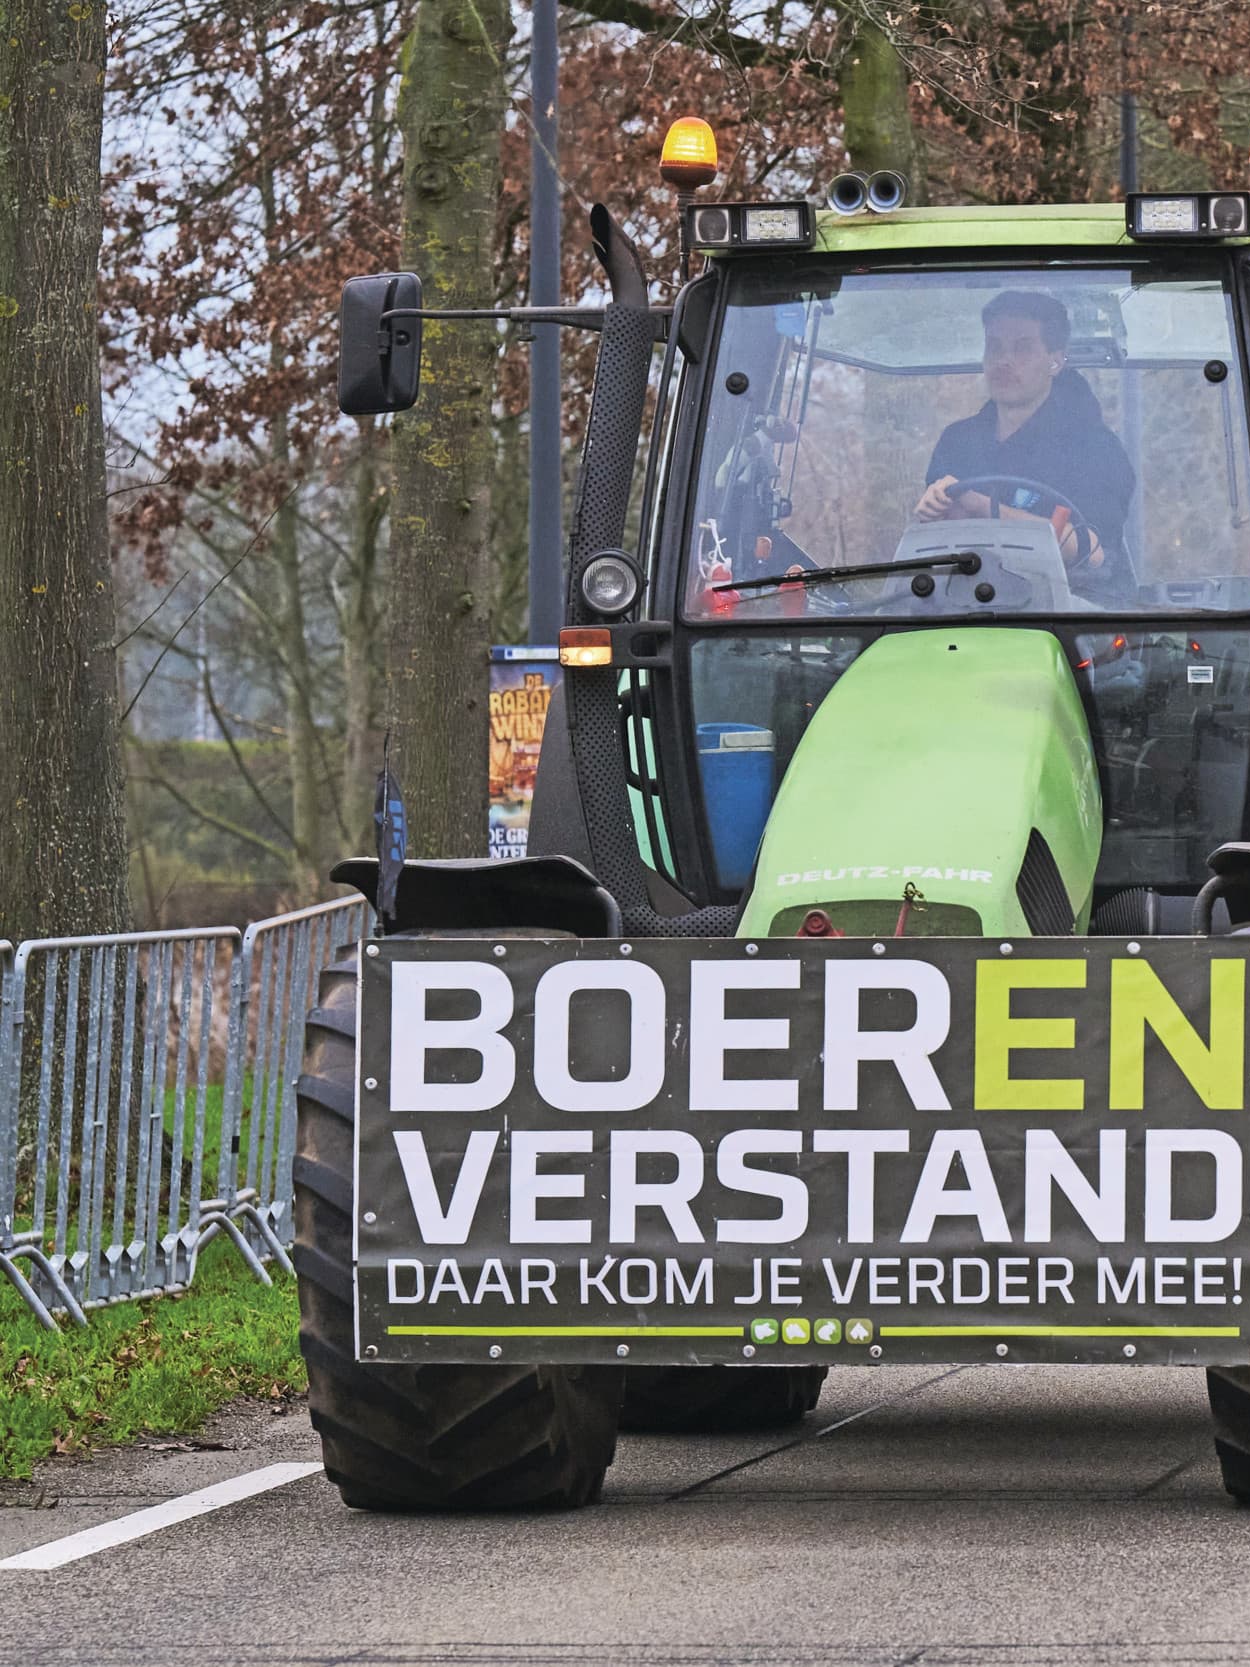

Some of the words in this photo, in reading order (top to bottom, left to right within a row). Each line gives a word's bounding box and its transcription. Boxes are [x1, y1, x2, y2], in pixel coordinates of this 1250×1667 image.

[525, 673, 543, 689] DE
[777, 866, 993, 886] DEUTZ-FAHR
[390, 959, 1245, 1112] BOEREN
[393, 1129, 1242, 1244] VERSTAND
[387, 1258, 557, 1304] DAAR
[580, 1258, 713, 1304] KOM
[735, 1258, 802, 1304] JE
[822, 1258, 1074, 1304] VERDER
[1098, 1257, 1242, 1304] MEE!
